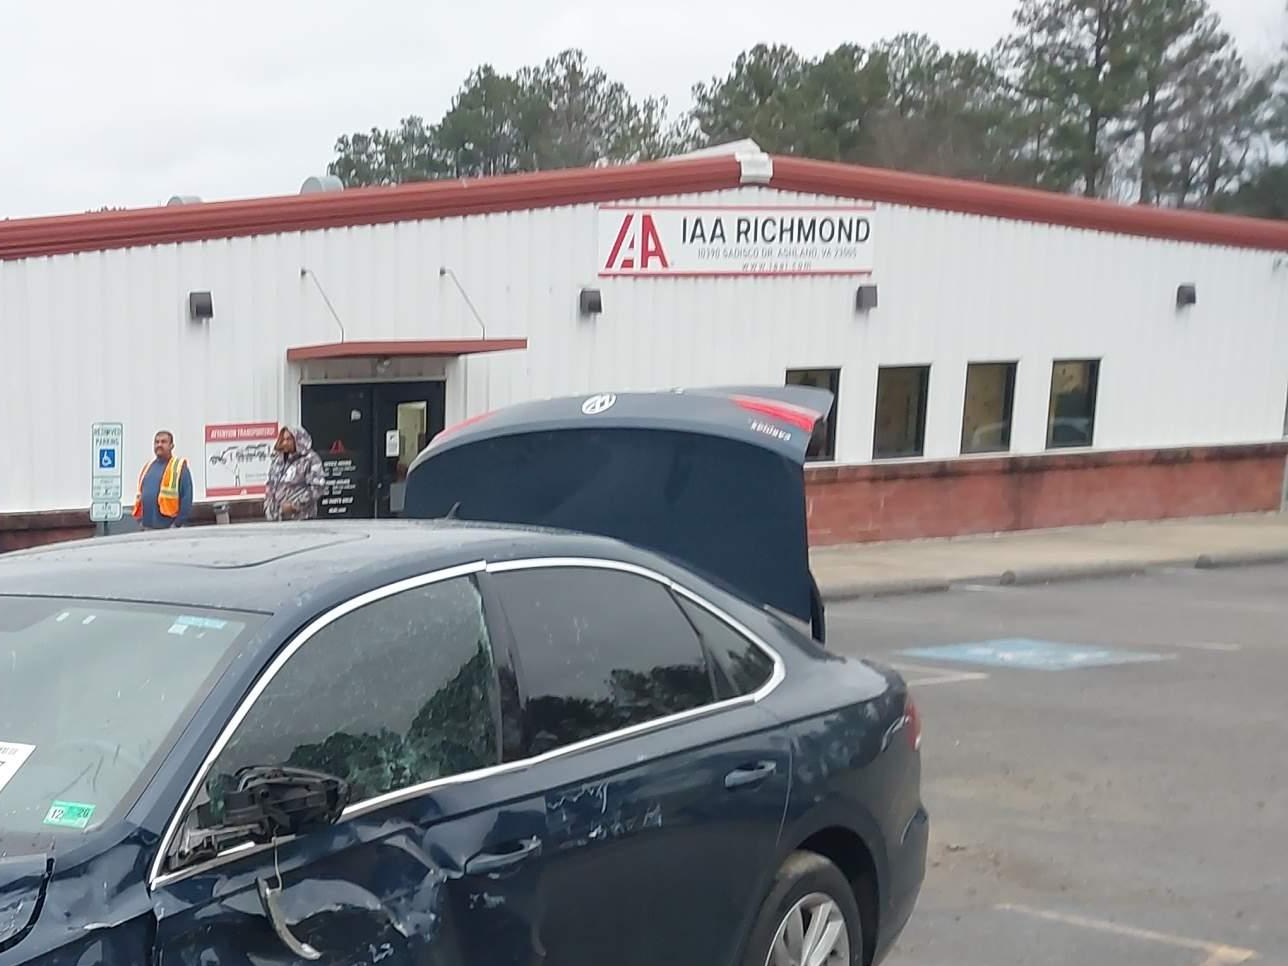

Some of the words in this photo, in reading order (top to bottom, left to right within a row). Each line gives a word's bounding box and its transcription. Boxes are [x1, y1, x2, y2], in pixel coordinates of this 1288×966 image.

[681, 218, 726, 244] IAA
[736, 216, 870, 244] RICHMOND
[51, 809, 64, 819] 12
